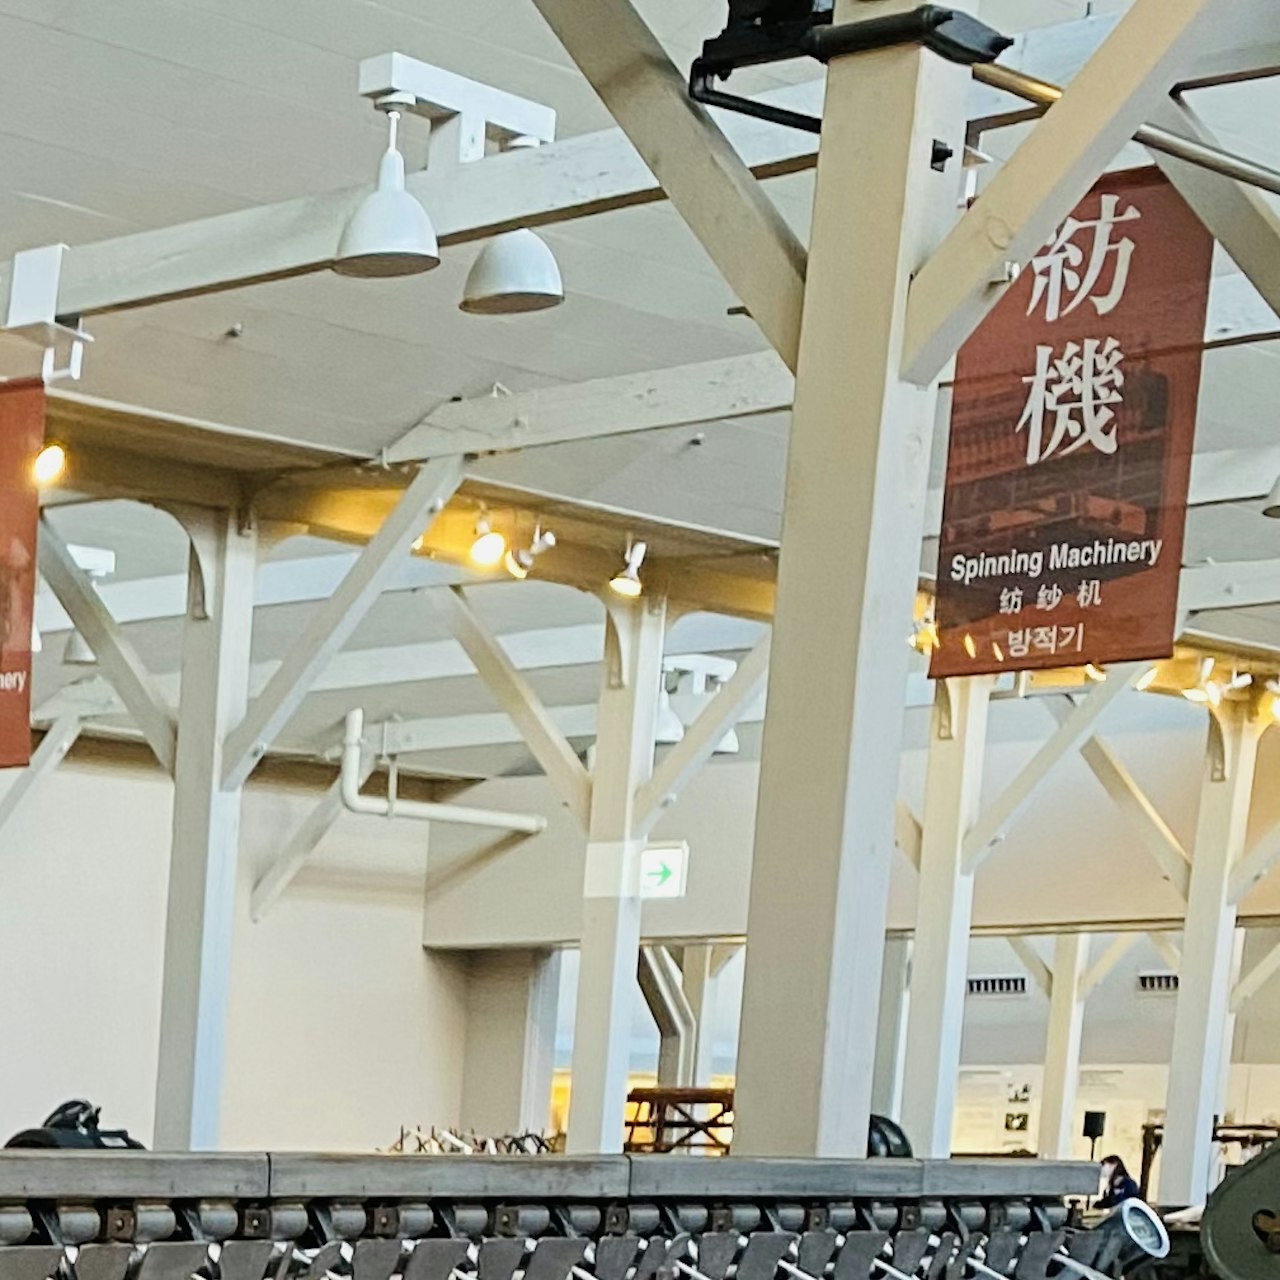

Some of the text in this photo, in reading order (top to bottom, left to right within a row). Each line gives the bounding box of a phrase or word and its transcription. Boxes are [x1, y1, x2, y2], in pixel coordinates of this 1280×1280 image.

[1015, 194, 1142, 465] 紡機
[950, 538, 1163, 585] Spinning Machinery
[1007, 622, 1085, 658] 방적기
